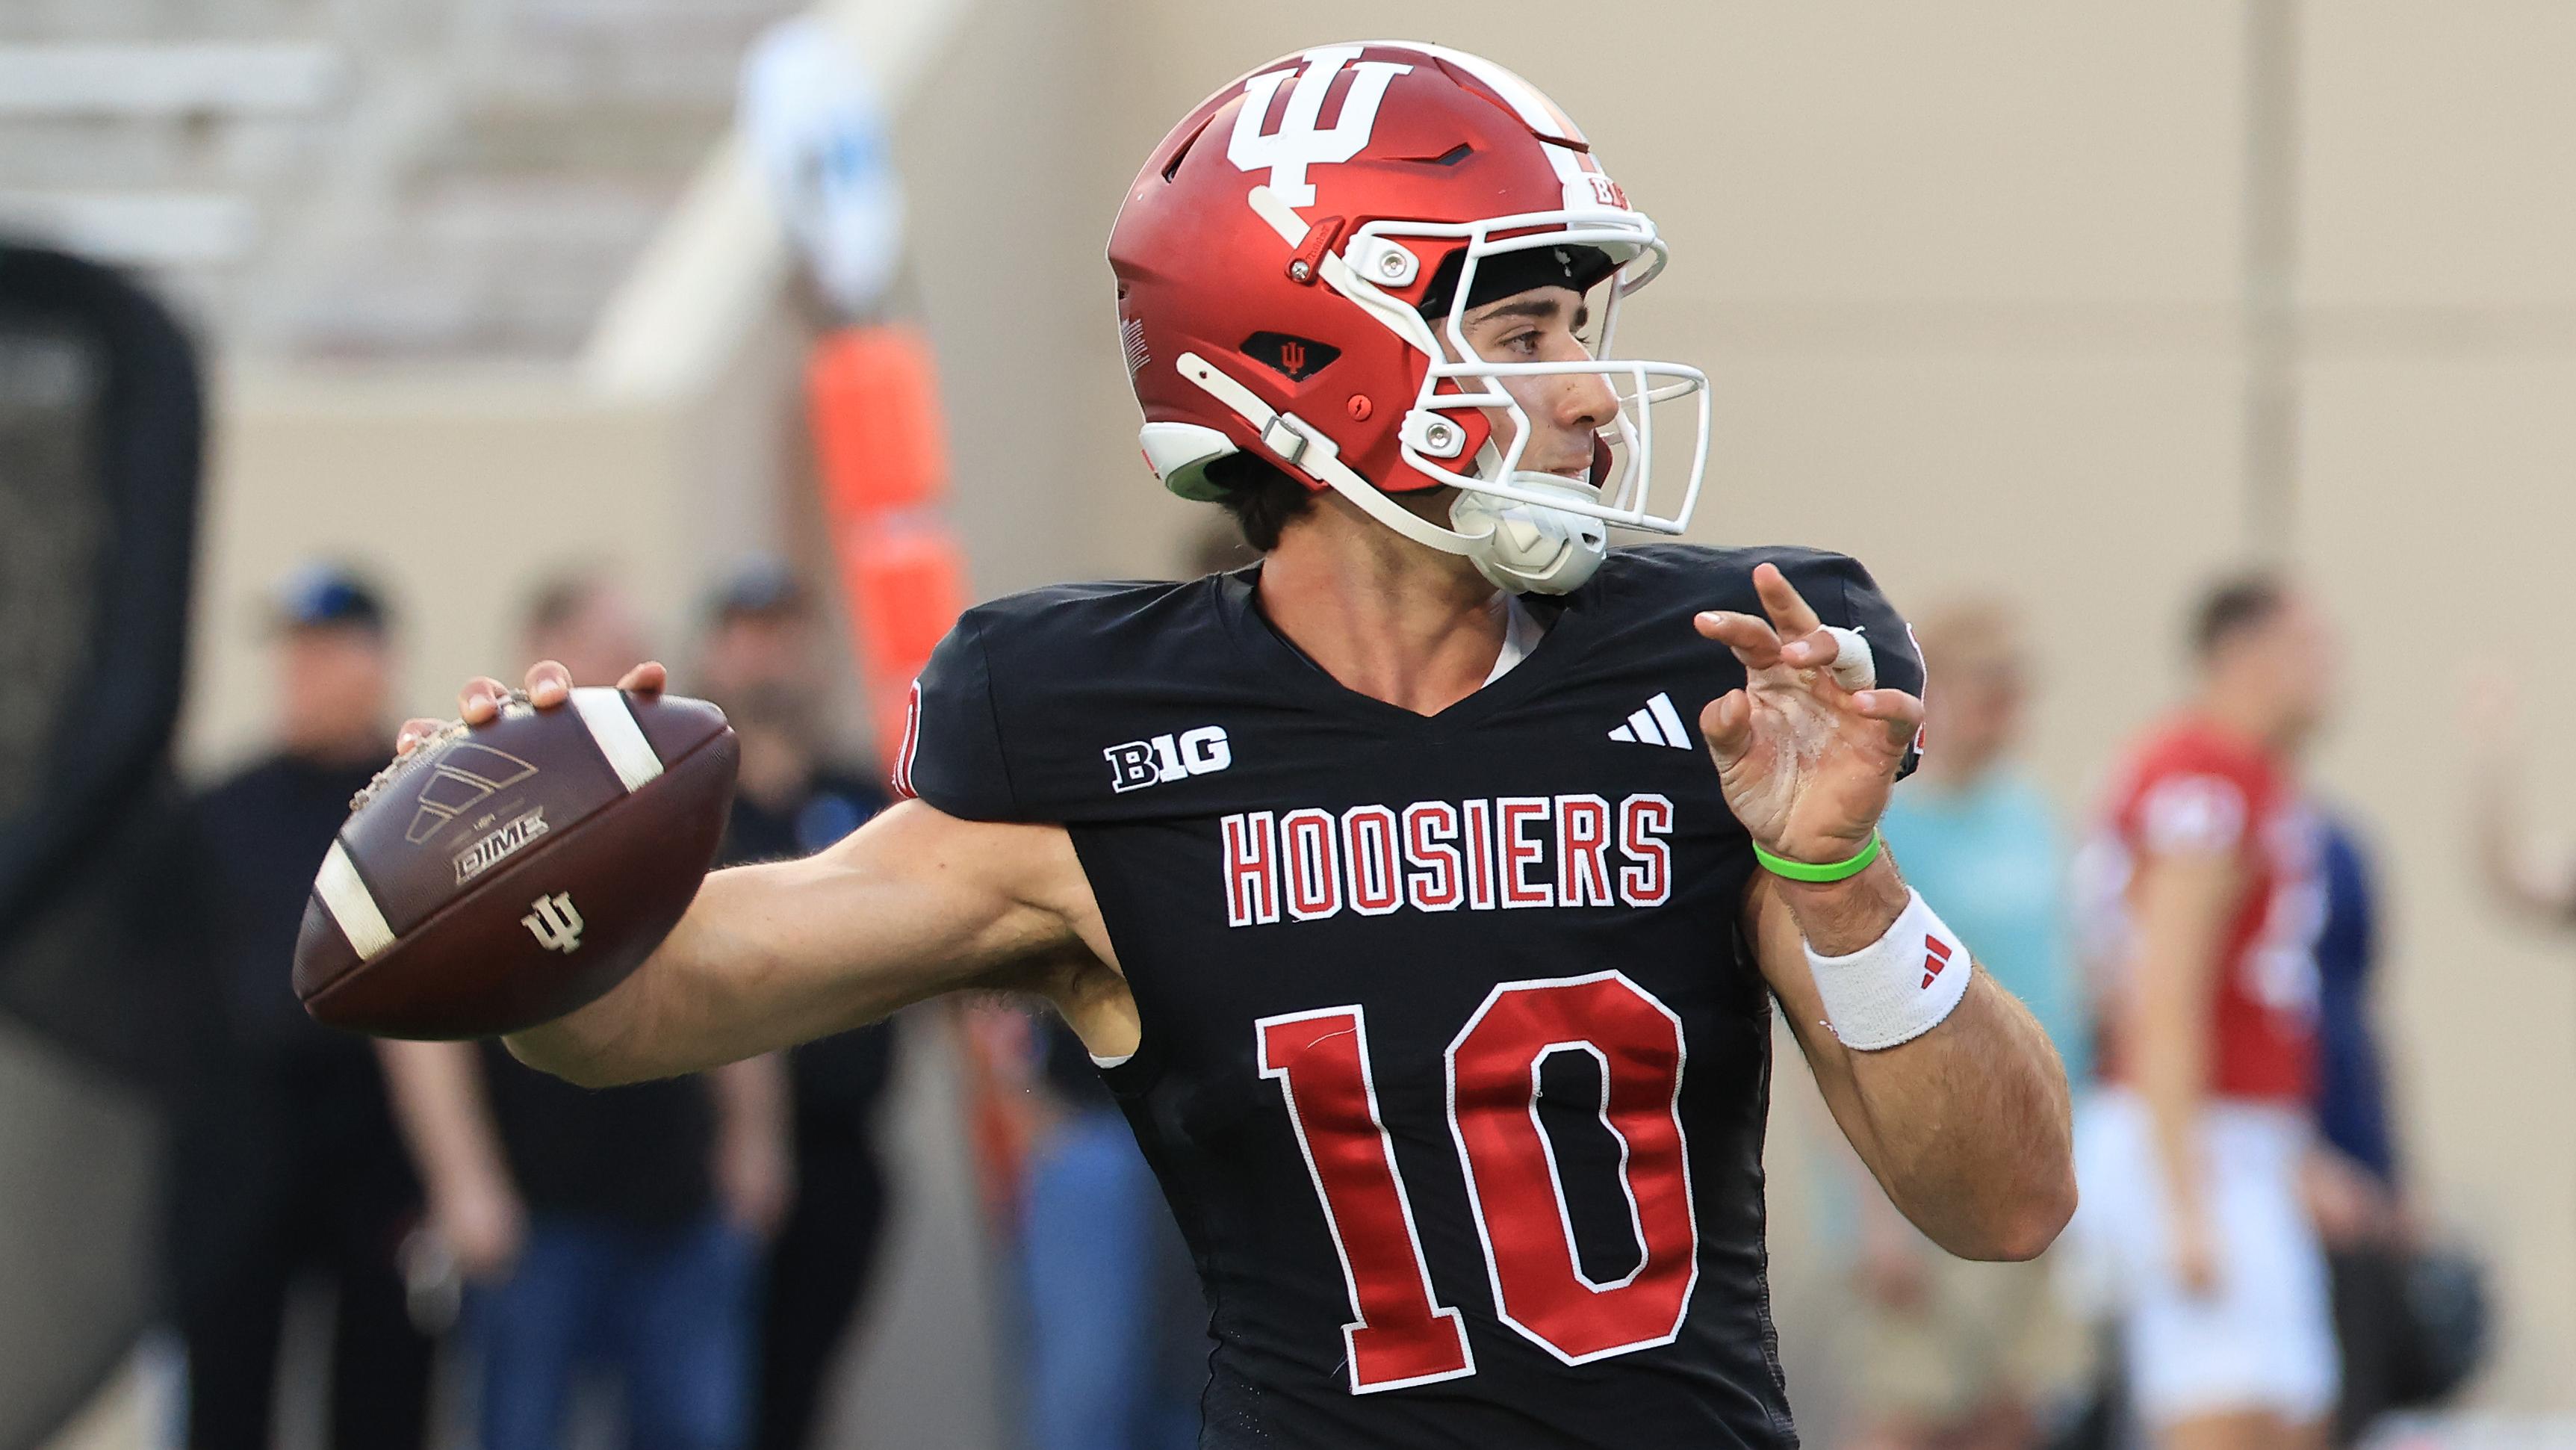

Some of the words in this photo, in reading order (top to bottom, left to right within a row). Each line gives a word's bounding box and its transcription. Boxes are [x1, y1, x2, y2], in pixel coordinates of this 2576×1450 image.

[453, 805, 550, 885] DIME
[1220, 793, 1674, 928] HOOSIERS
[1255, 969, 1698, 1395] 10
